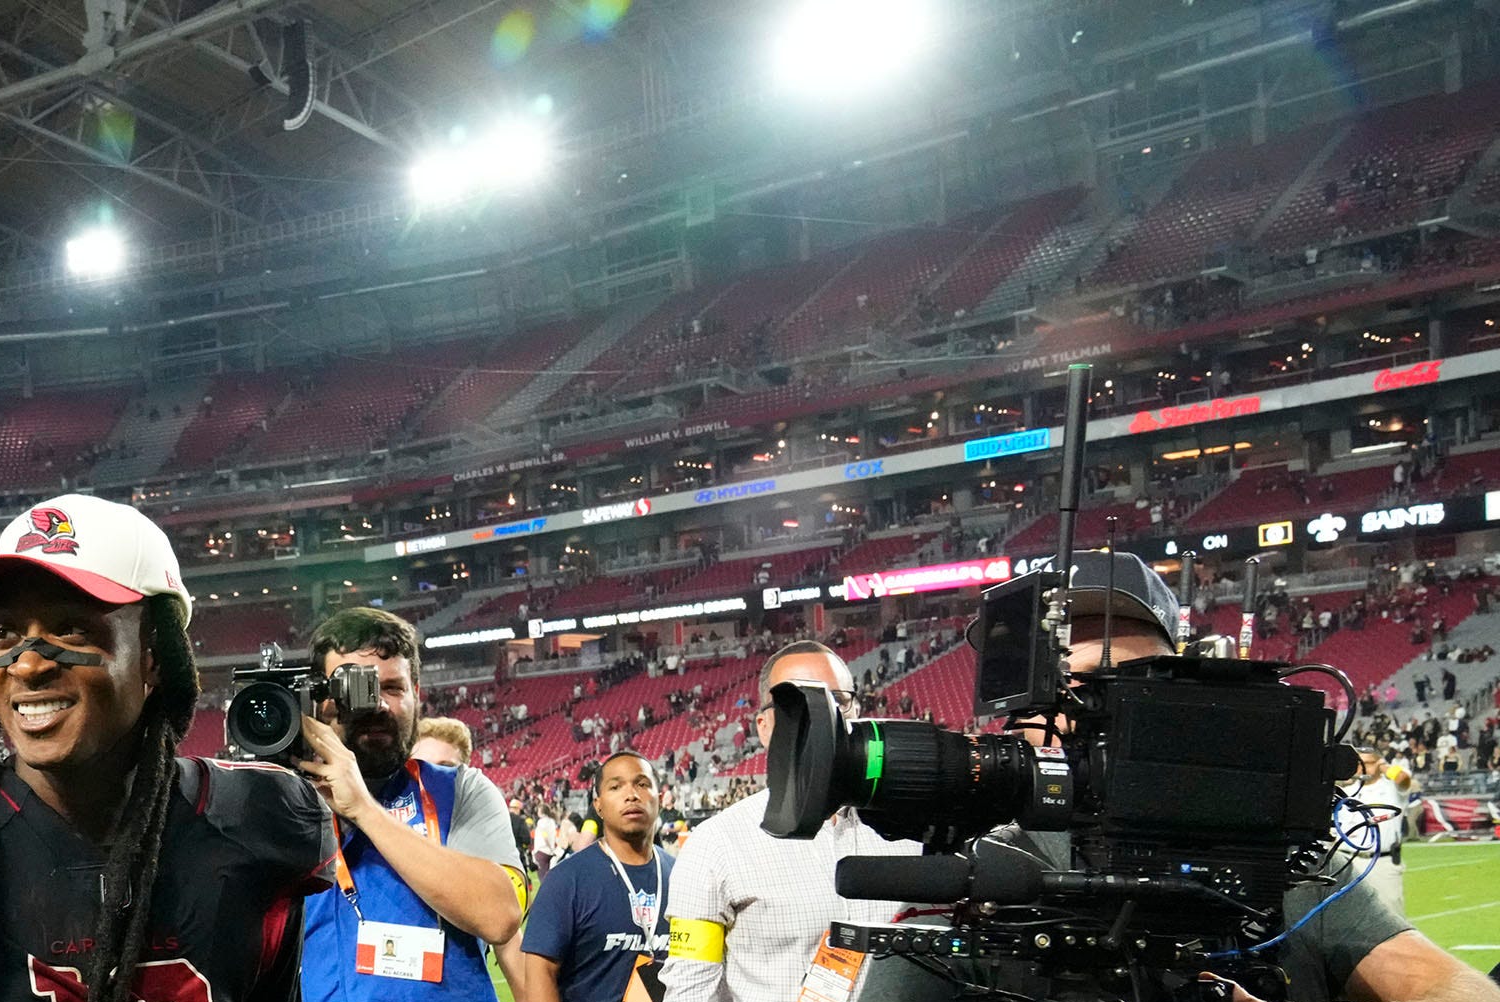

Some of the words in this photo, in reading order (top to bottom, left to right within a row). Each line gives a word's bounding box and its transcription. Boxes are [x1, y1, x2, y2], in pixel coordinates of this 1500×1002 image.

[1022, 355, 1047, 371] PAT
[1050, 343, 1112, 364] TILLMAN
[624, 431, 670, 449] WILLIAM
[672, 429, 683, 439] V.
[685, 420, 731, 437] BIDWILL
[453, 465, 494, 482] CHARLES
[844, 459, 885, 480] COX
[716, 479, 776, 500] HYUNDAI
[582, 502, 636, 524] SAFEWAY
[1361, 503, 1445, 534] SAINTS
[1202, 534, 1229, 551] ON
[634, 907, 653, 922] NFL
[50, 936, 179, 954] CARLS
[603, 932, 670, 952] FILM
[684, 932, 691, 943] 7
